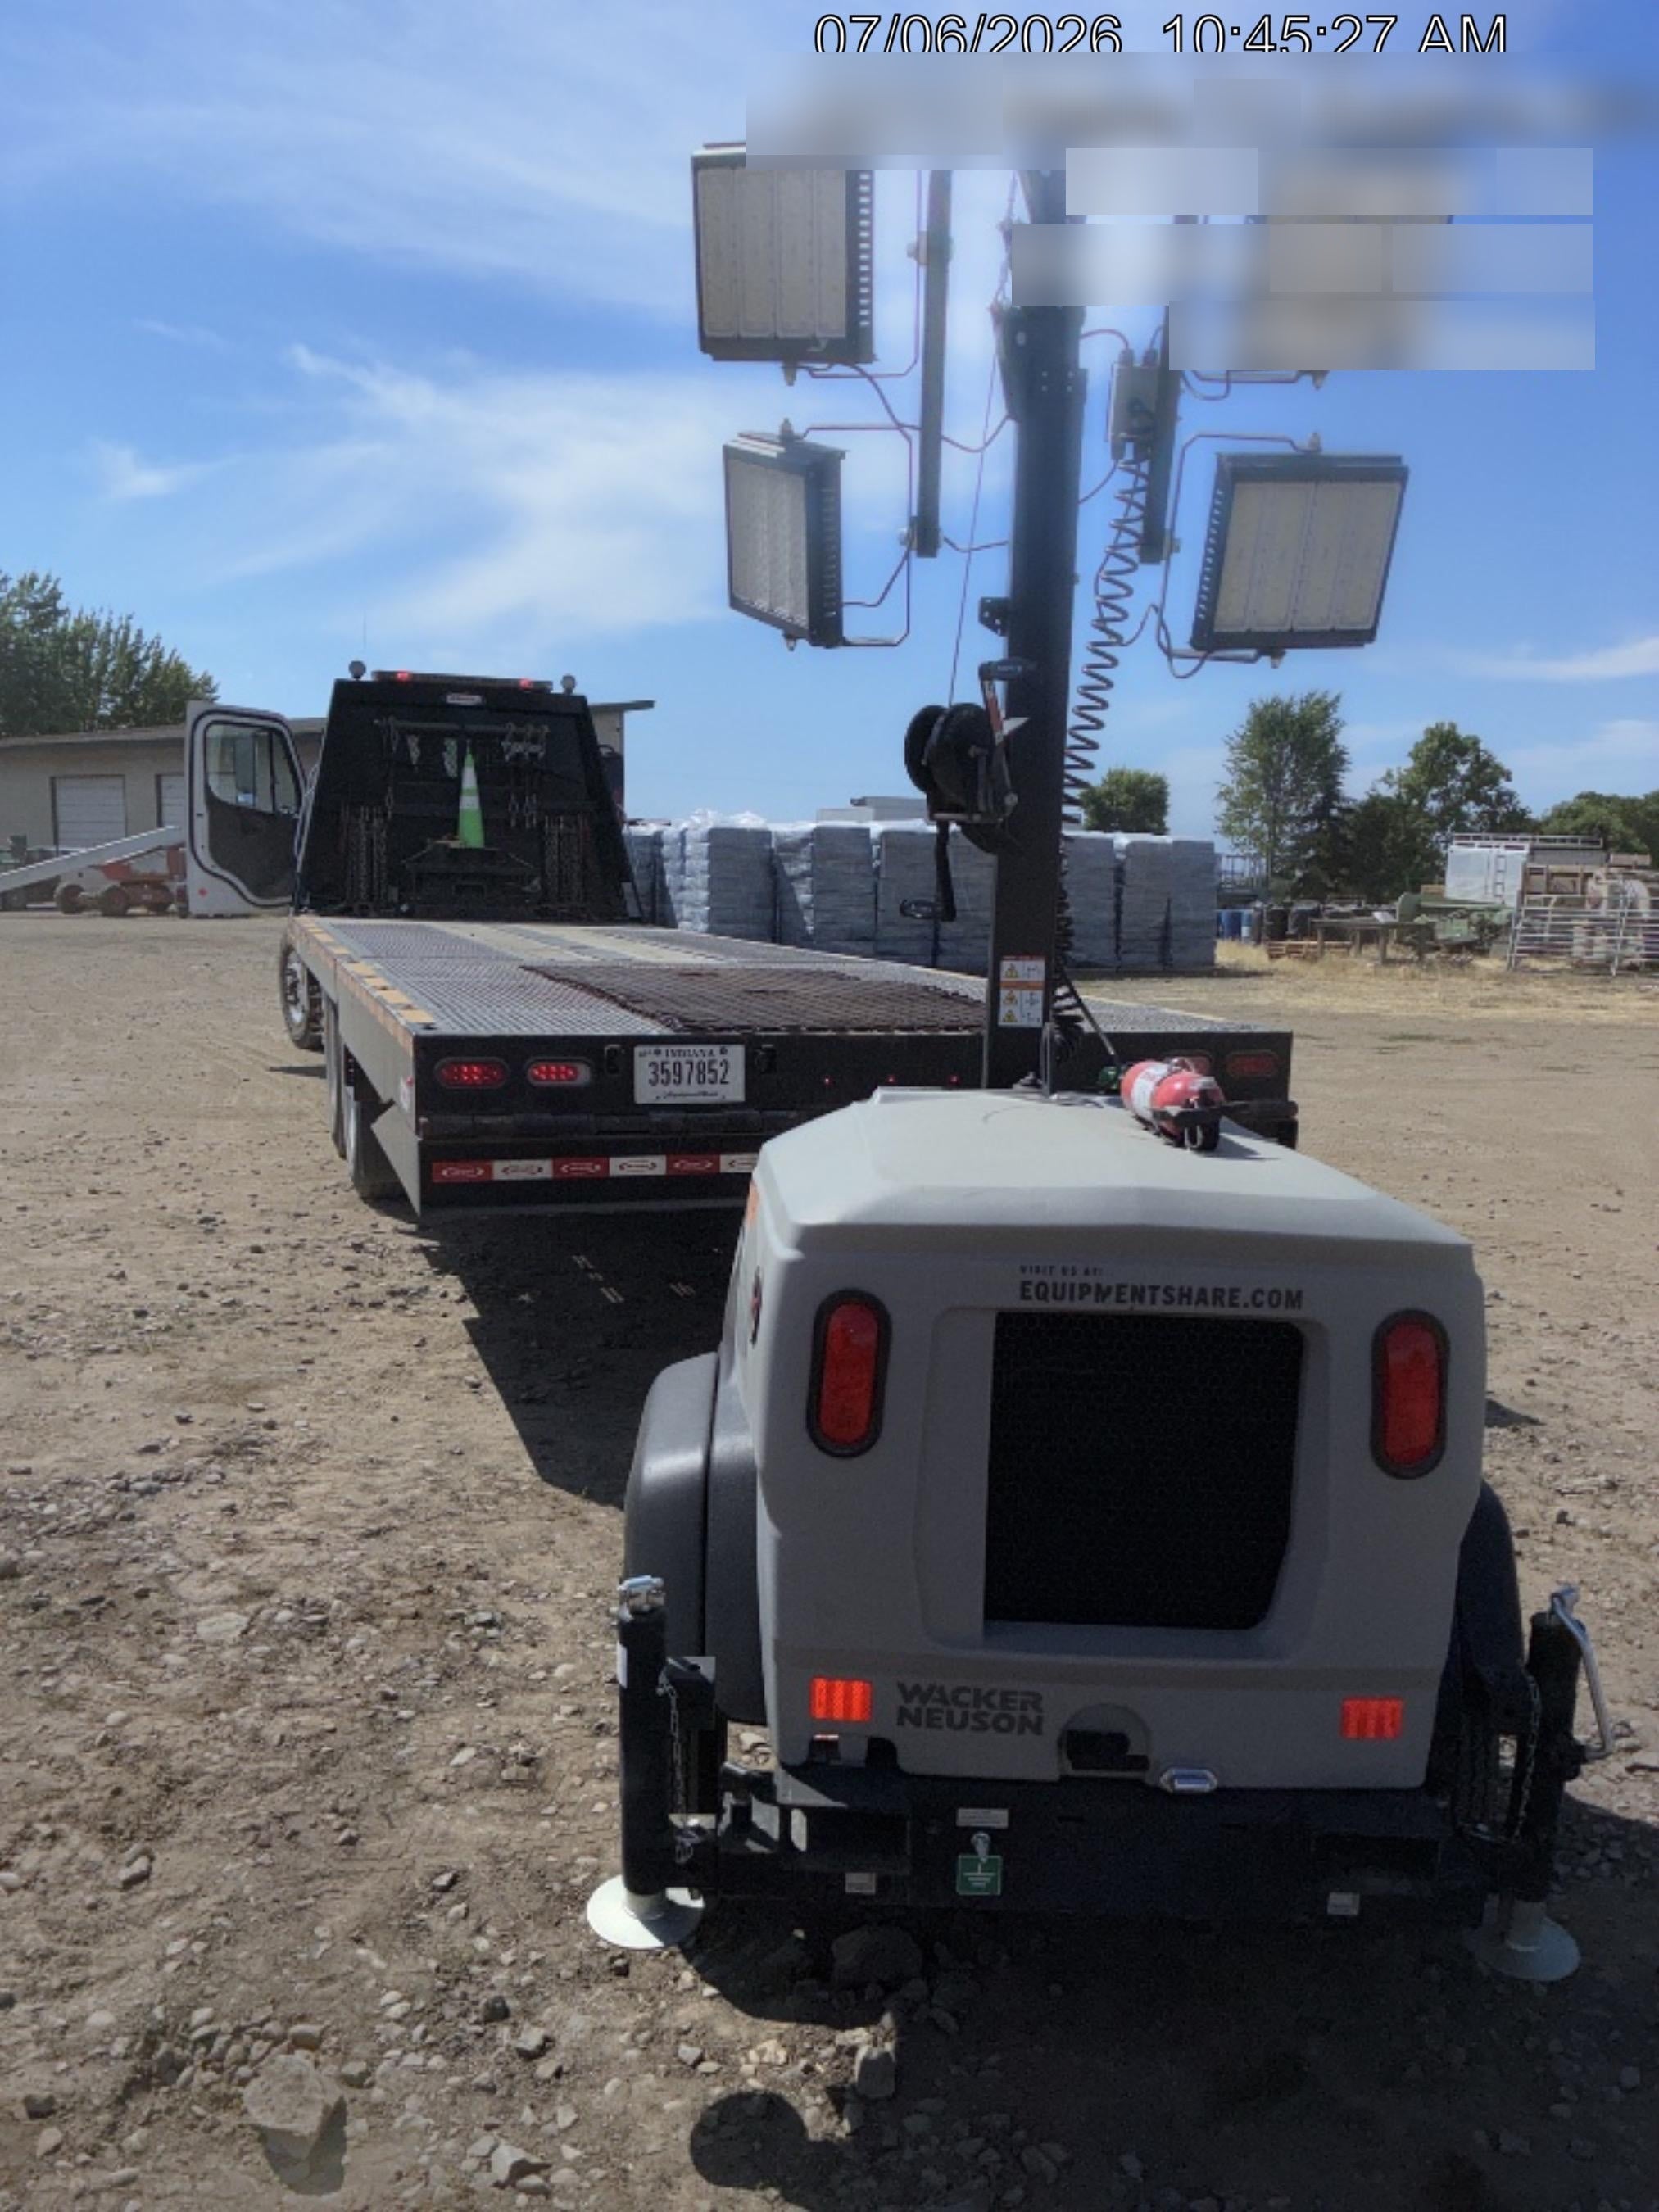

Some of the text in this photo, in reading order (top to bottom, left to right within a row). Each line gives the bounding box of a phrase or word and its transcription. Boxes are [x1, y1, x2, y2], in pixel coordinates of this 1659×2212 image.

[648, 1059, 729, 1086] 3597852
[1019, 1281, 1303, 1310] EQUIPMENTSHARE.COM
[896, 1681, 1043, 1712] WACKER
[896, 1705, 1043, 1735] NEUSON
